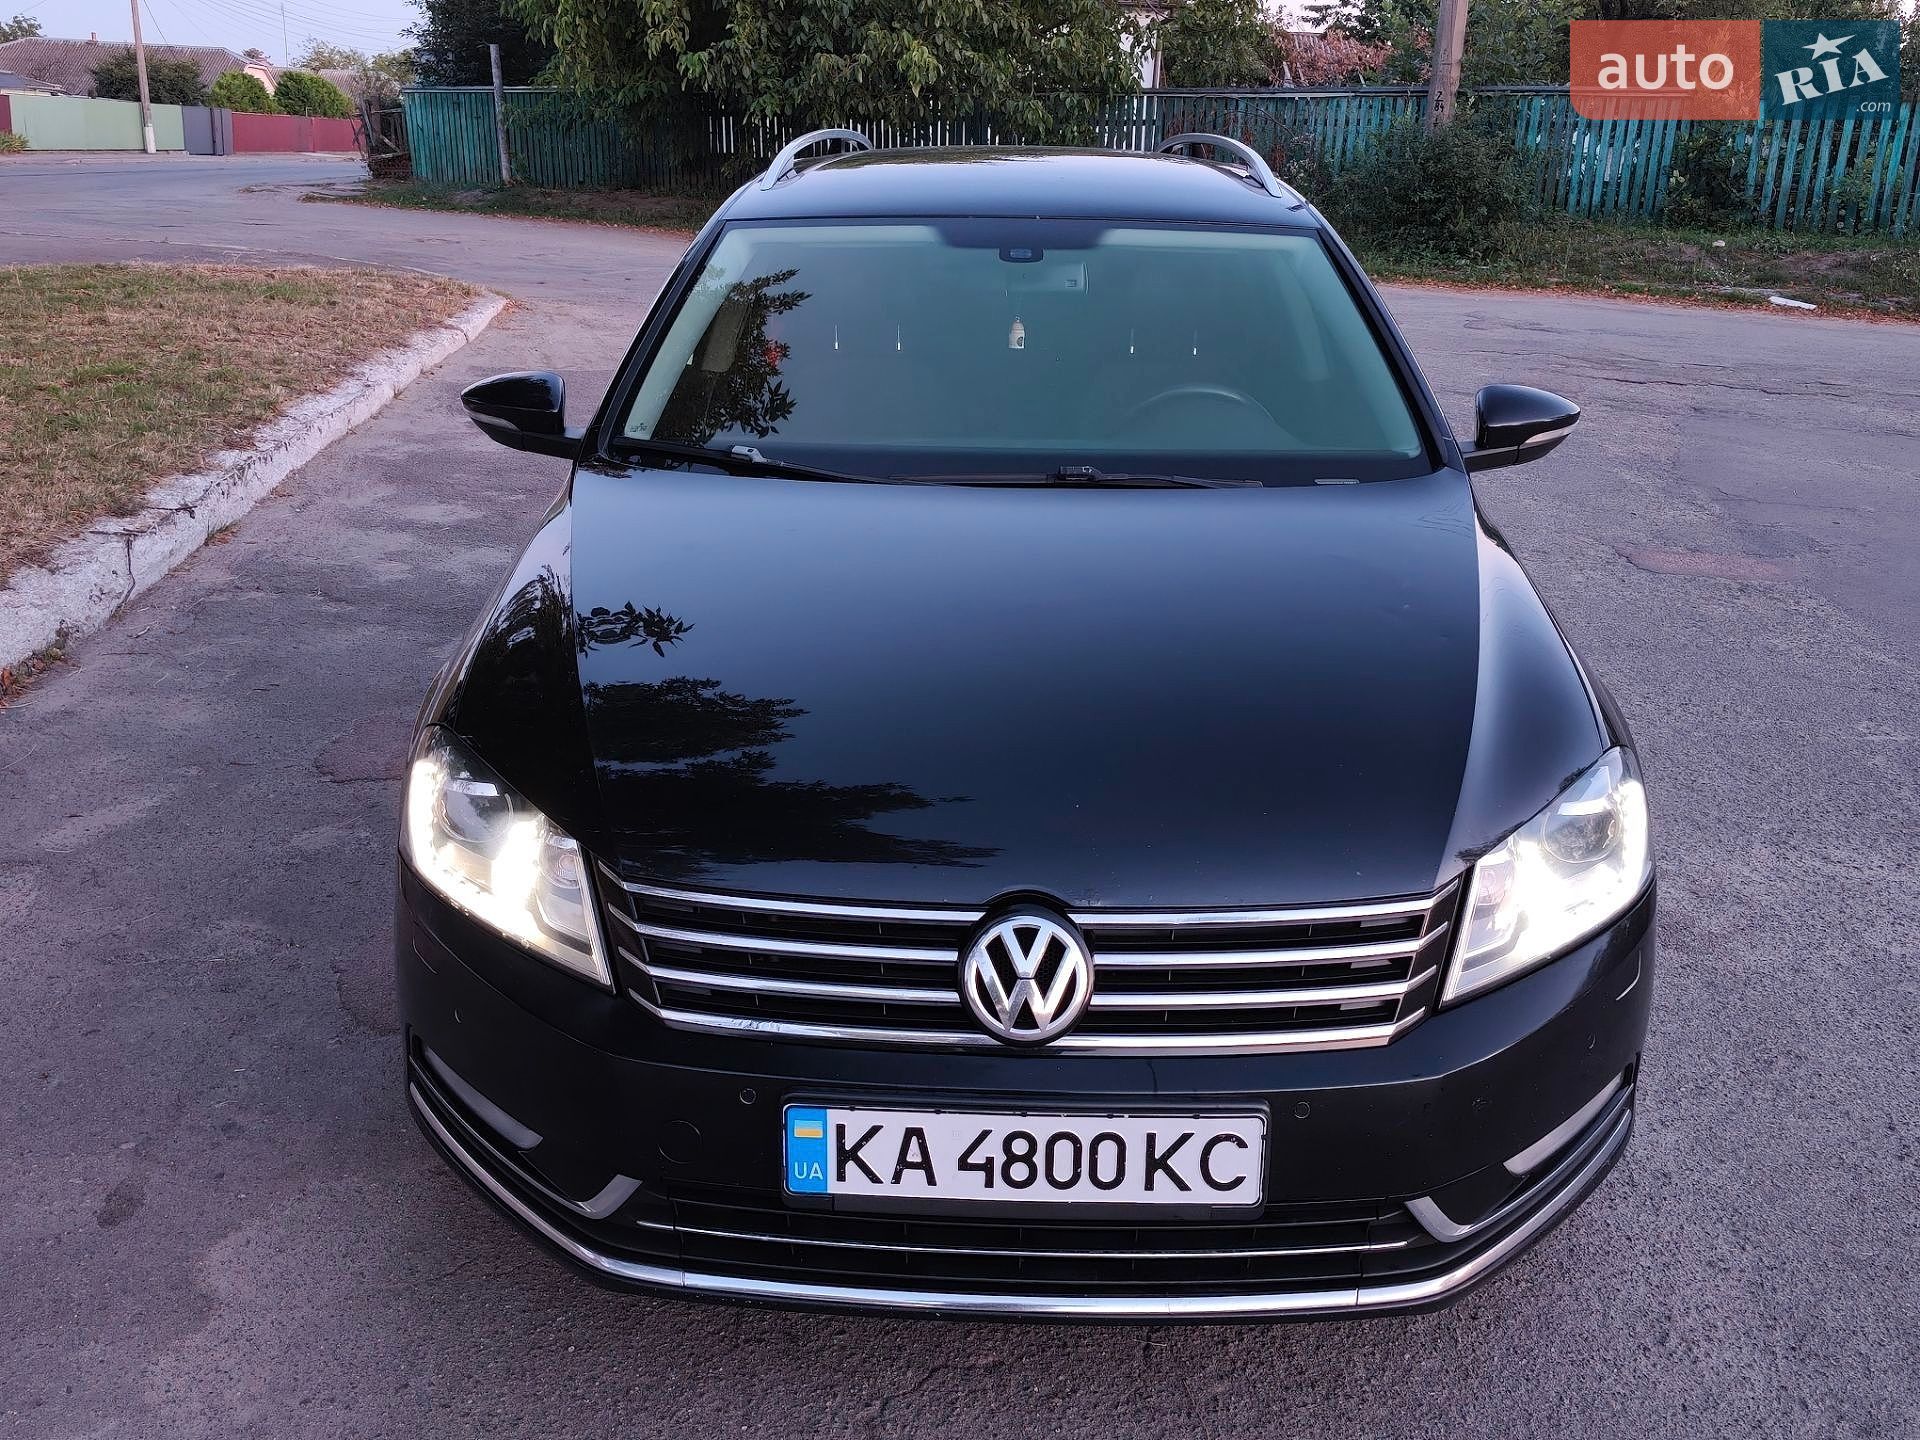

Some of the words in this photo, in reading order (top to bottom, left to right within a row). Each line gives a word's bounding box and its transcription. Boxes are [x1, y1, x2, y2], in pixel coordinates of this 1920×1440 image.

[794, 1162, 823, 1180] UA
[835, 1123, 937, 1186] KA
[957, 1129, 1126, 1191] 4800
[1144, 1132, 1249, 1192] KC
